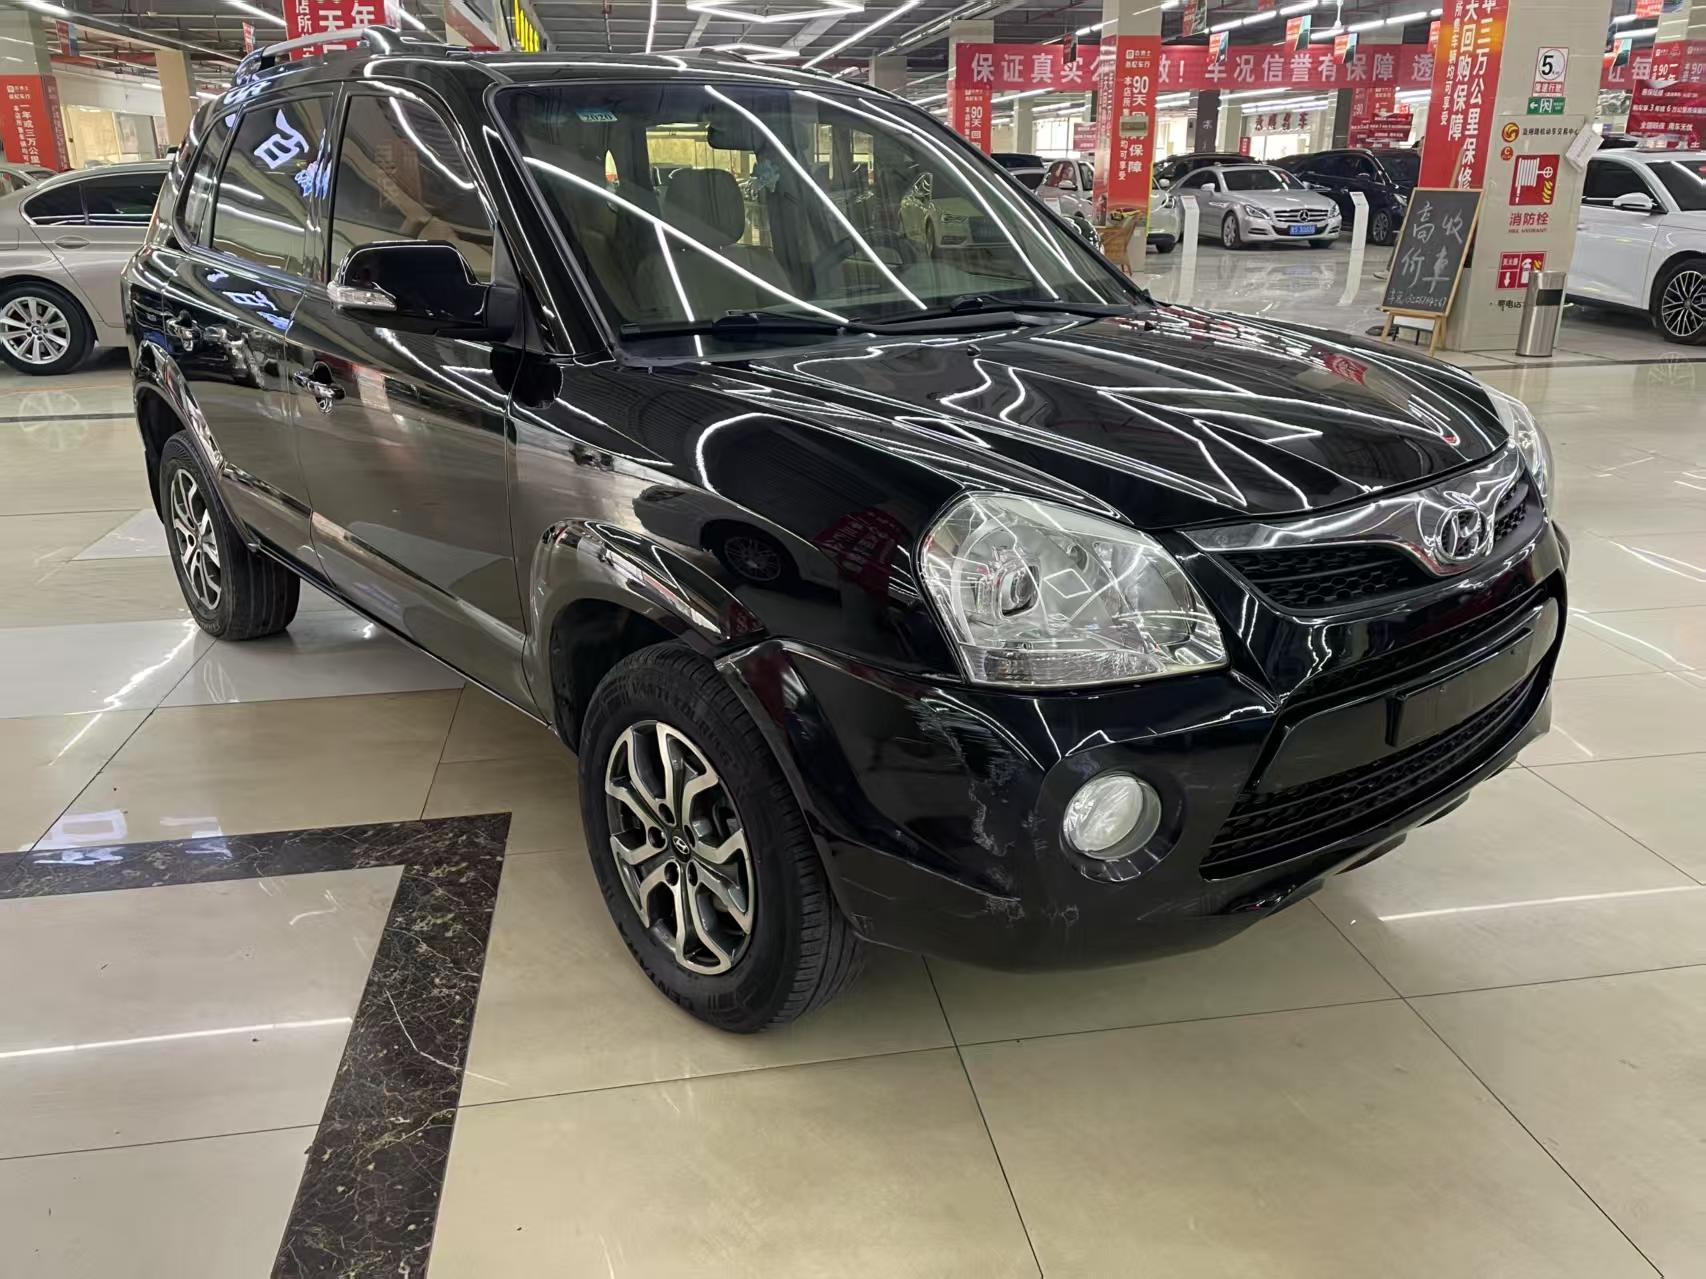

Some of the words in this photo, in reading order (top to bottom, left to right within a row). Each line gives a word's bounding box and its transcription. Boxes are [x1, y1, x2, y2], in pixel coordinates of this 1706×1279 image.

[1541, 55, 1554, 75] 5
[20, 104, 41, 167] 一年或三万公里
[1127, 76, 1150, 173] 90天保障
[1509, 212, 1549, 226] 消防栓
